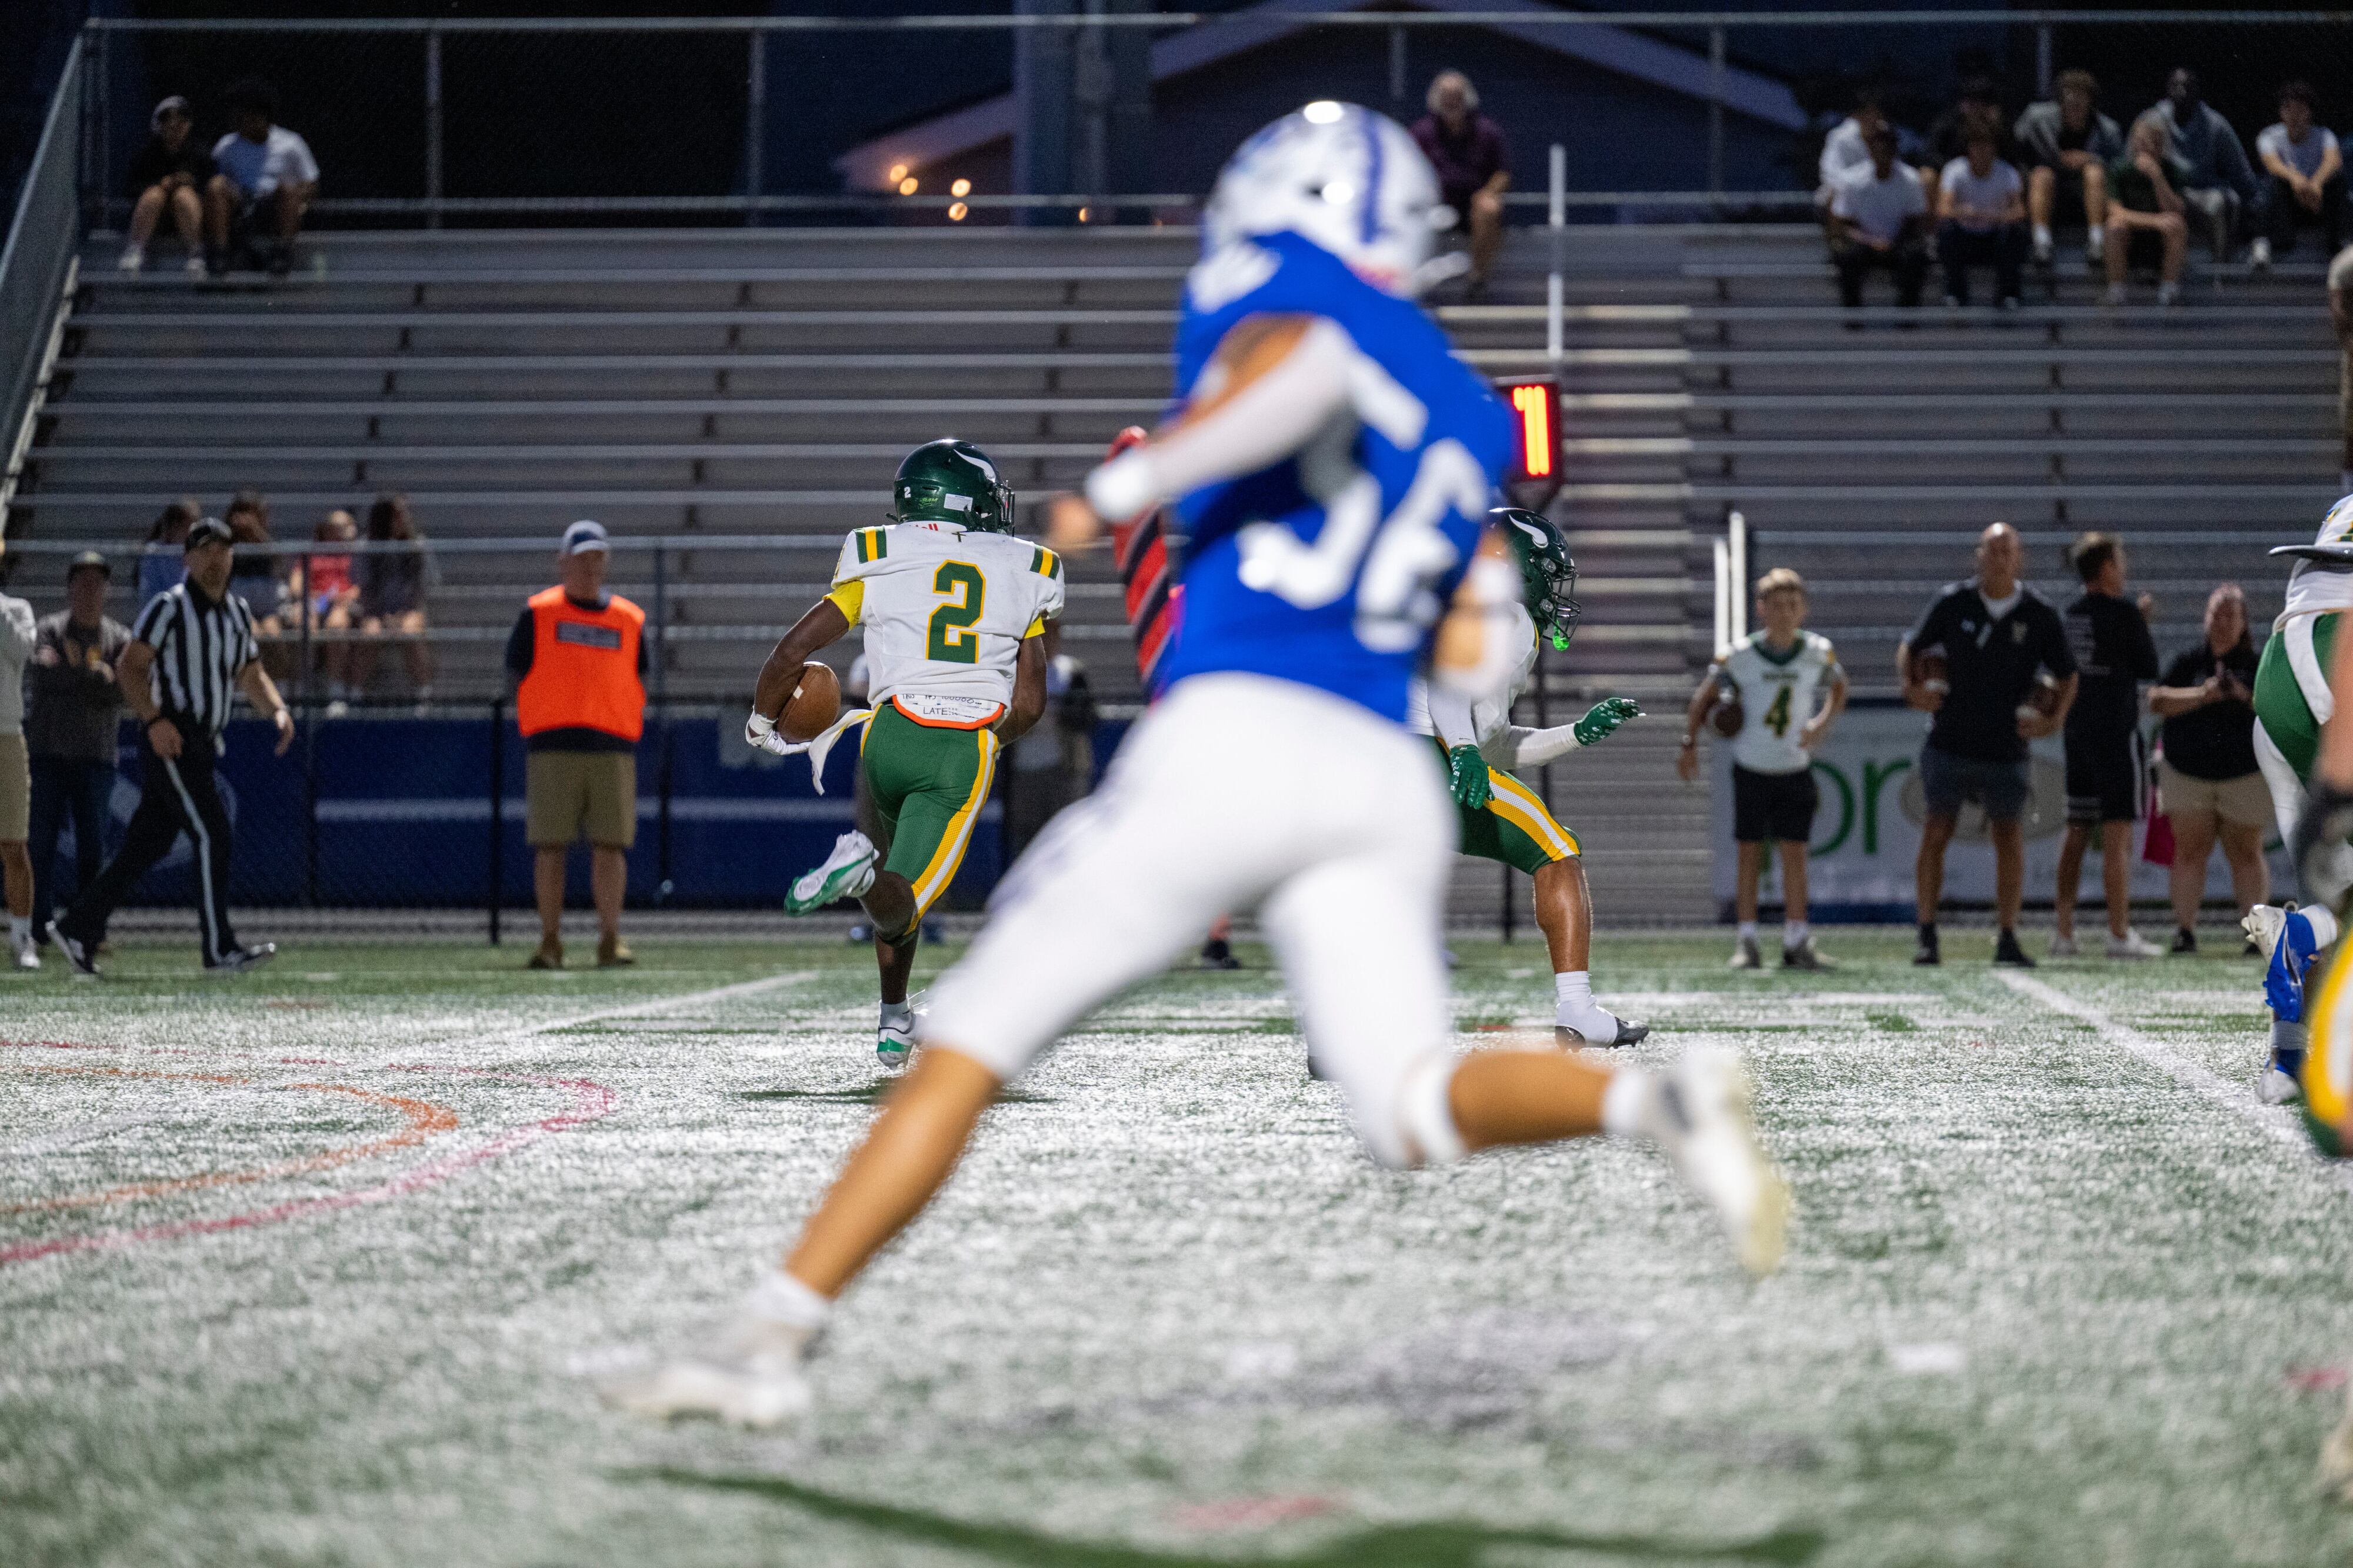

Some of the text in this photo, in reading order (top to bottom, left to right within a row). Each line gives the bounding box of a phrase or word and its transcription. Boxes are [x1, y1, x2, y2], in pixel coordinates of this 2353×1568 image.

[1513, 385, 1550, 475] 1
[904, 486, 911, 498] 2
[925, 559, 986, 664] 2
[1764, 684, 1792, 738] 4
